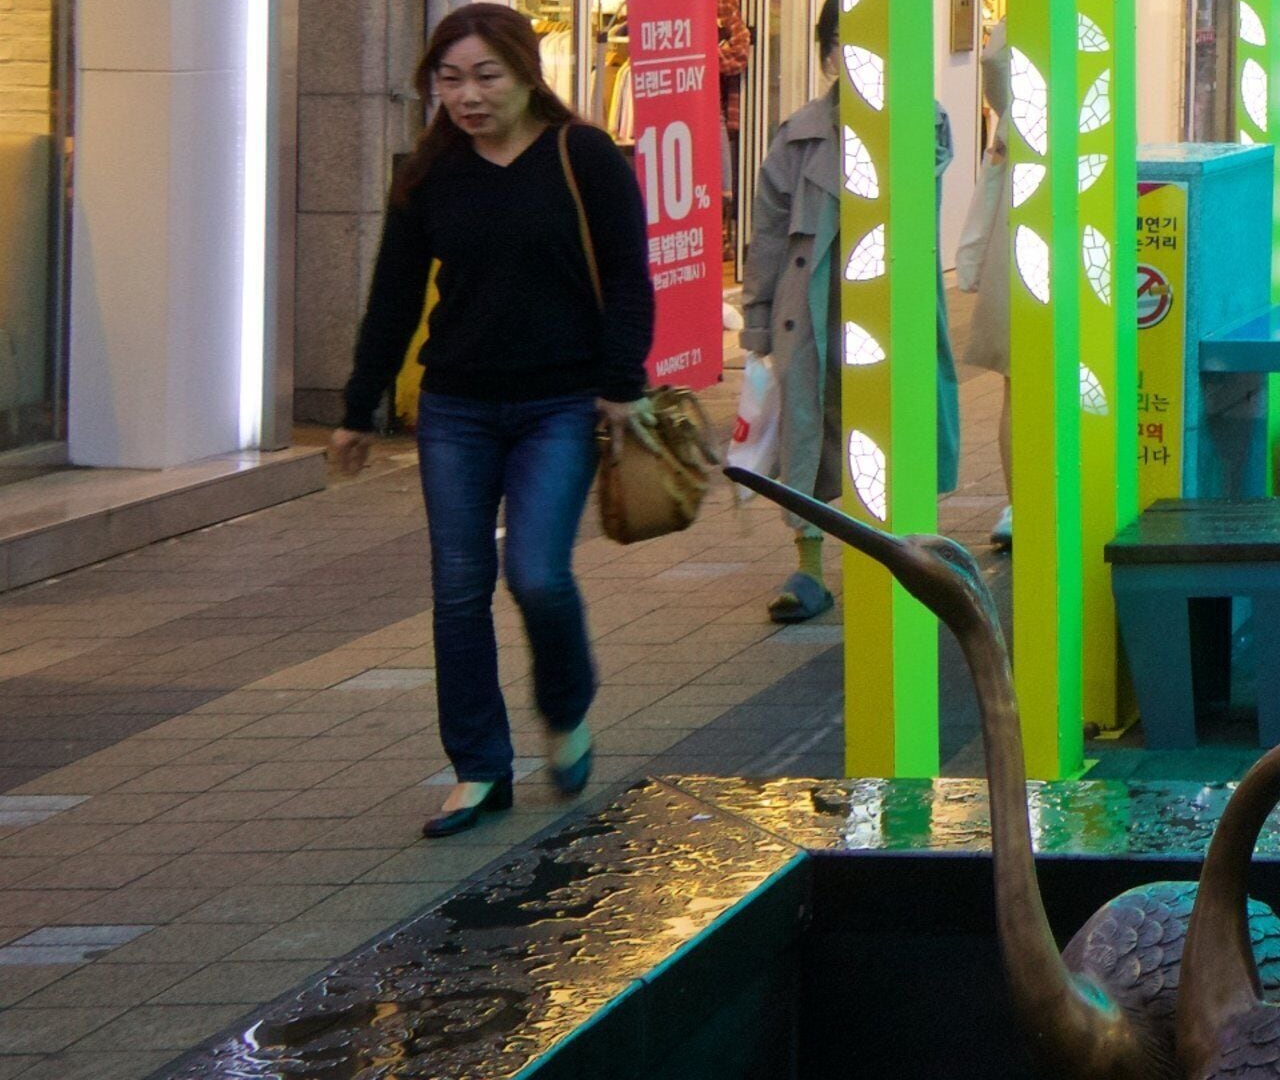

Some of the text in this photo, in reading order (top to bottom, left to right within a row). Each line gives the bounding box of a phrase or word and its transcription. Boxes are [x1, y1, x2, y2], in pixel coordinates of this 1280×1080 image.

[634, 65, 706, 99] 브랜드 DAY
[648, 226, 705, 266] 특별할인
[656, 347, 702, 377] MARKET 21
